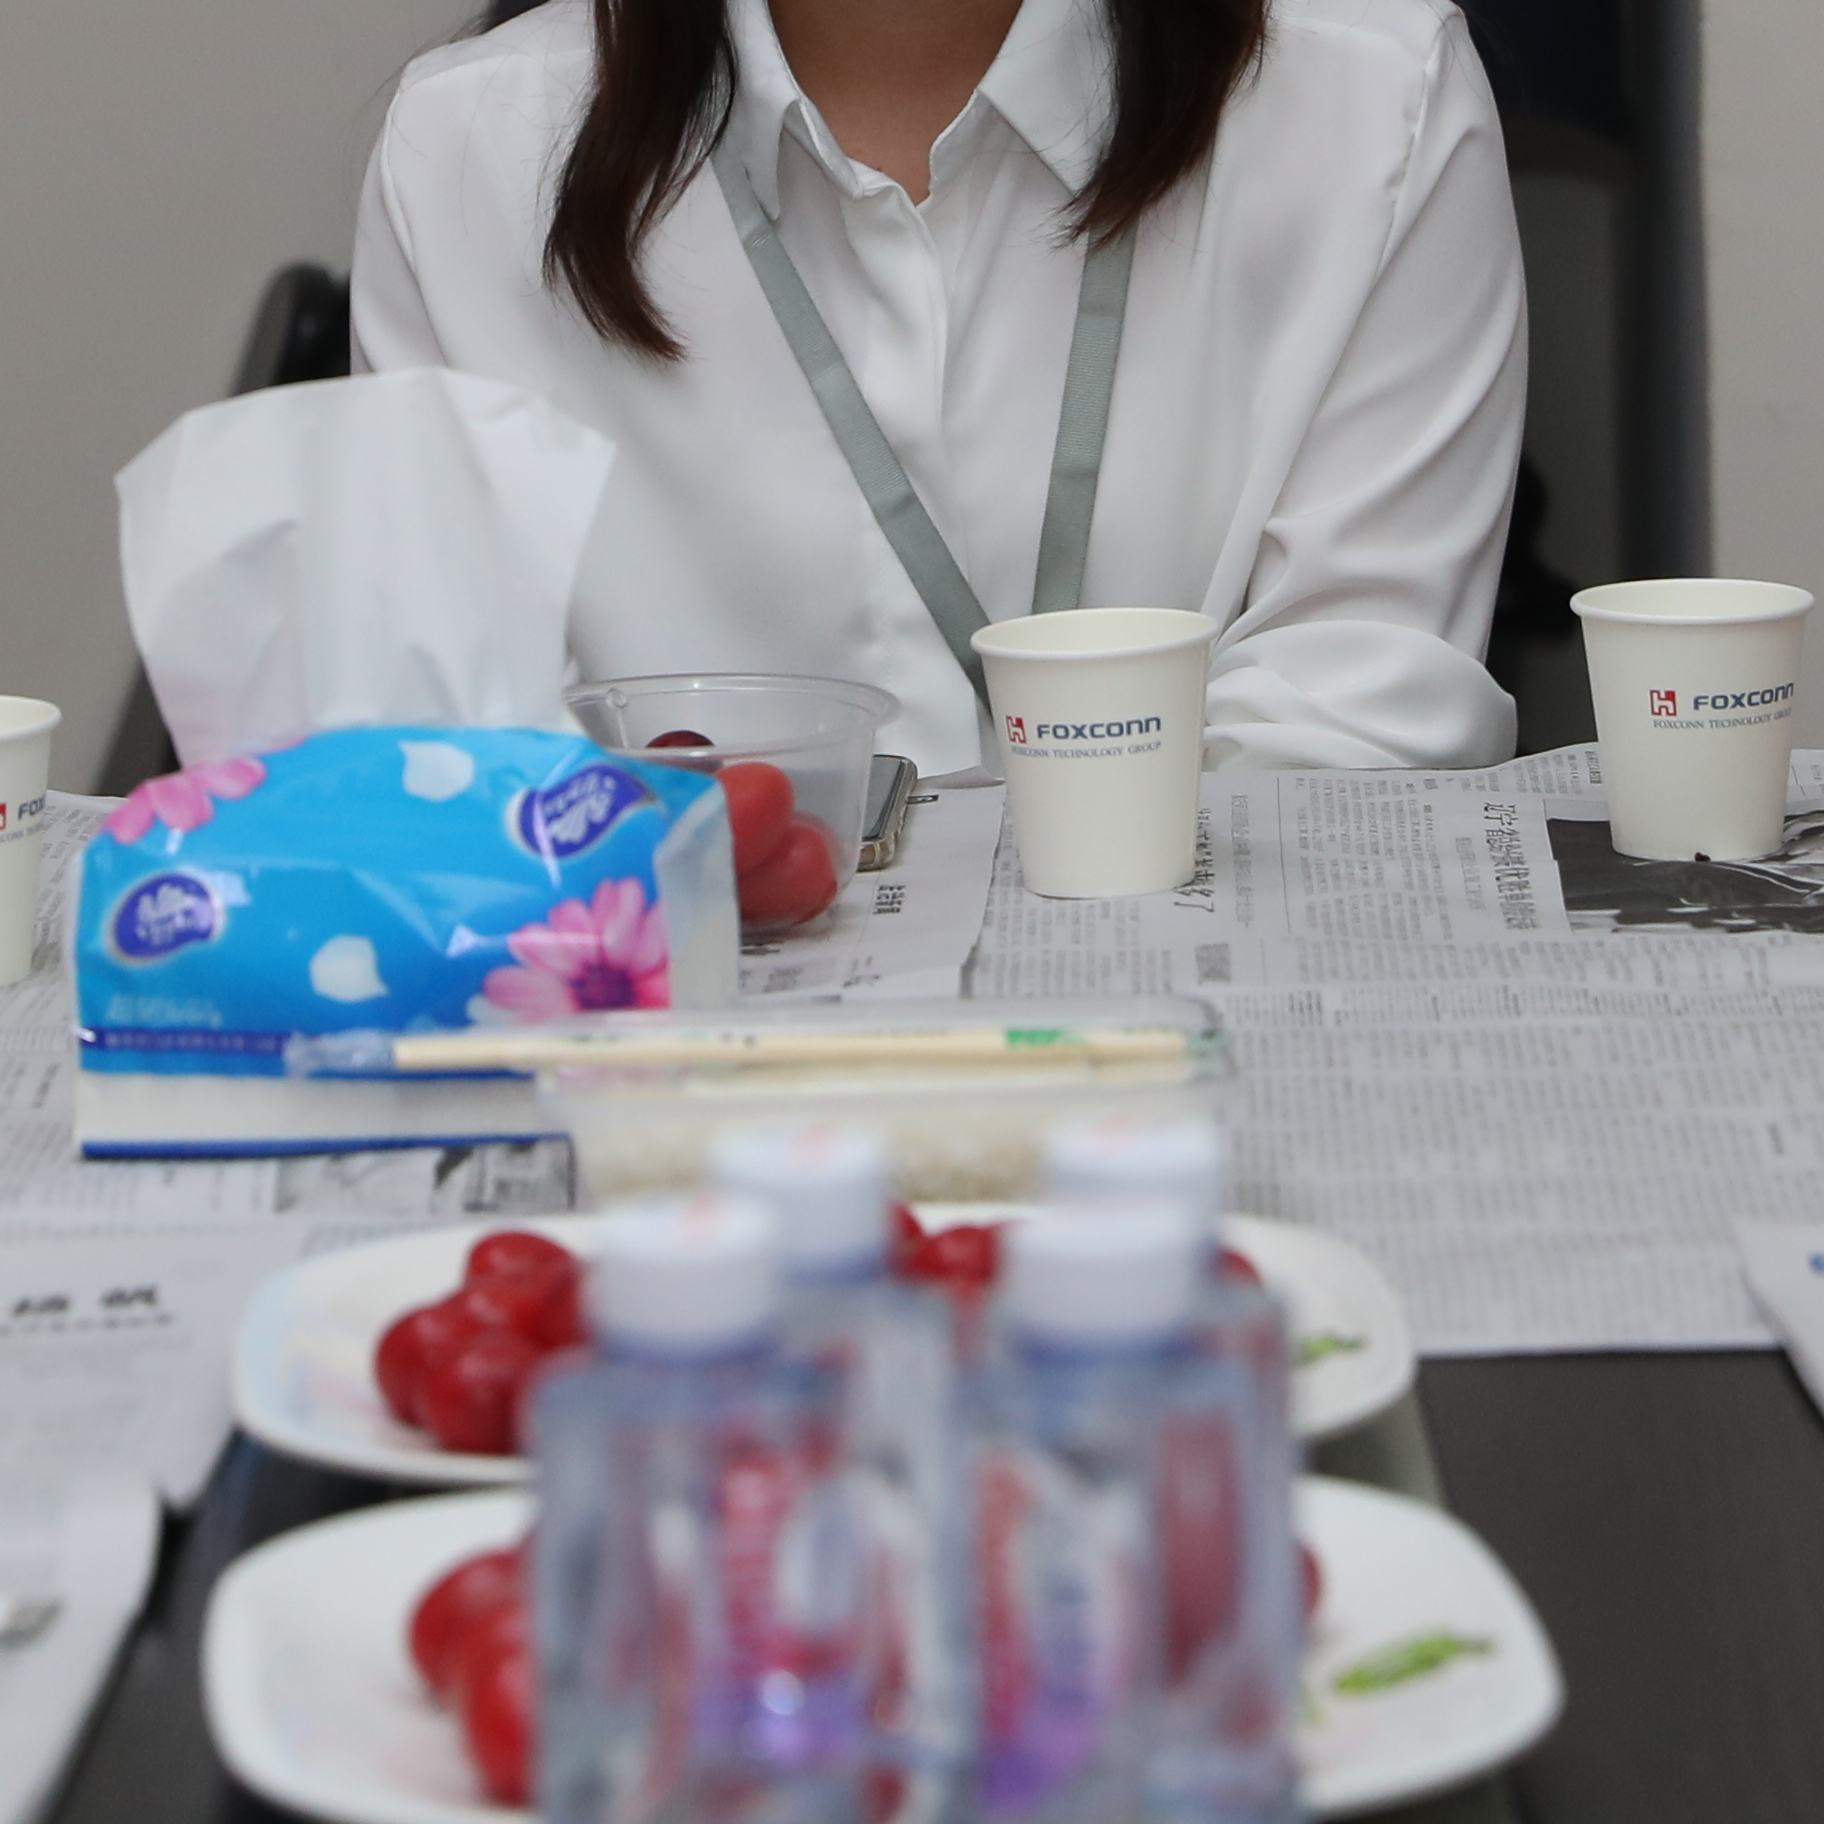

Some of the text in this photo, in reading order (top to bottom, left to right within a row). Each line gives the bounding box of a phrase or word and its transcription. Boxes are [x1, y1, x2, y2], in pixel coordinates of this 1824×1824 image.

[1708, 713, 1773, 729] TECHNOLOGY
[1053, 746, 1123, 759] TECHNOLOGY
[1127, 741, 1161, 754] GROUP
